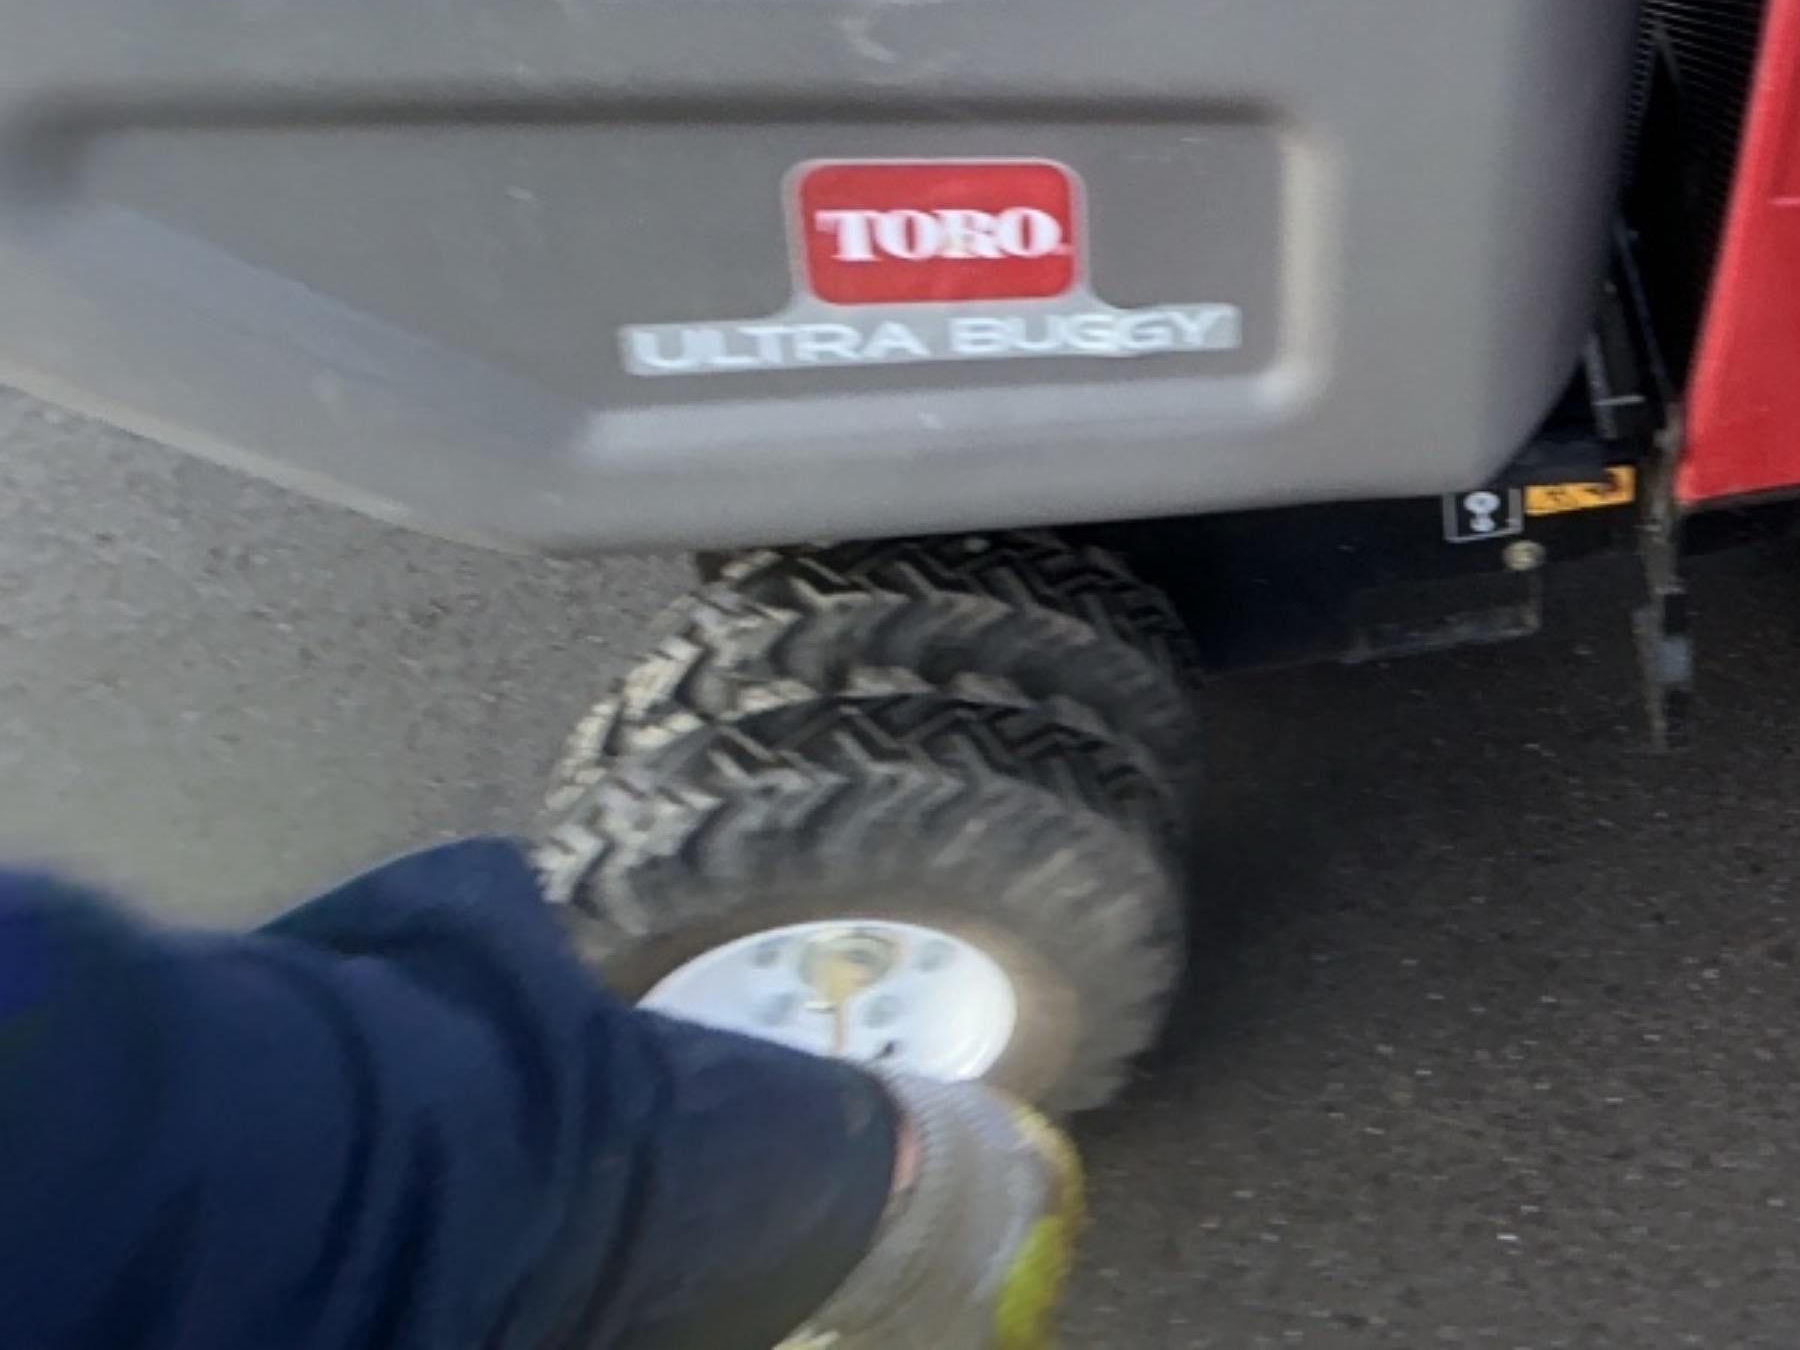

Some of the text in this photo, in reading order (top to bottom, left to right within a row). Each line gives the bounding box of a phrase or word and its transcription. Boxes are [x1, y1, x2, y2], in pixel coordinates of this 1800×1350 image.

[817, 207, 1062, 261] TORO
[632, 310, 1226, 370] ULTRA BUGGY
